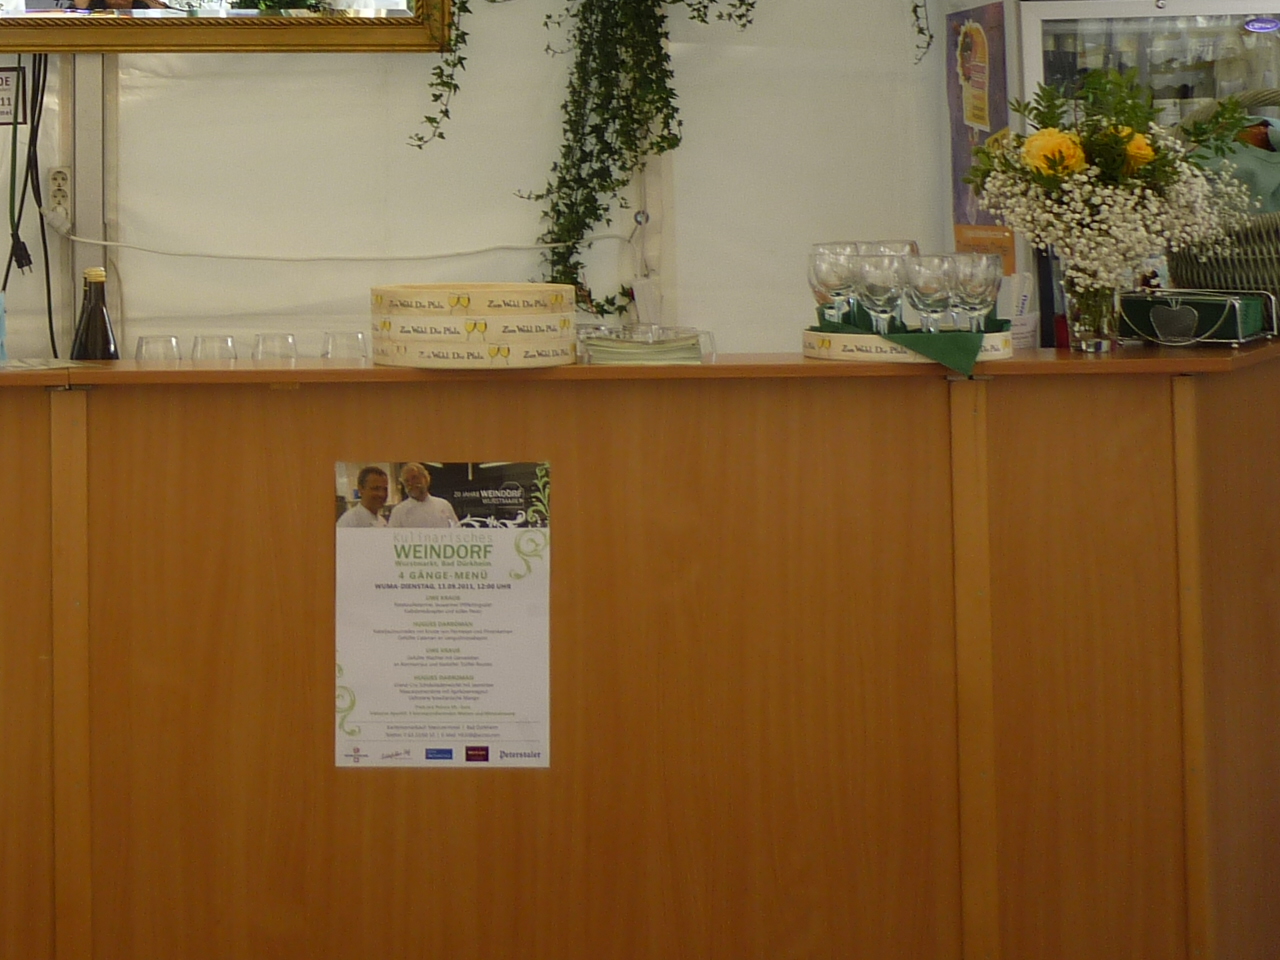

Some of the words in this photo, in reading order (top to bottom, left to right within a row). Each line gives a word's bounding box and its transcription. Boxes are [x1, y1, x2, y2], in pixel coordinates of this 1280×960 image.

[480, 488, 523, 498] WEINDORF
[393, 544, 494, 559] WEINDORF
[398, 571, 405, 579] 4
[409, 569, 488, 580] GÄNGE-MENÜ
